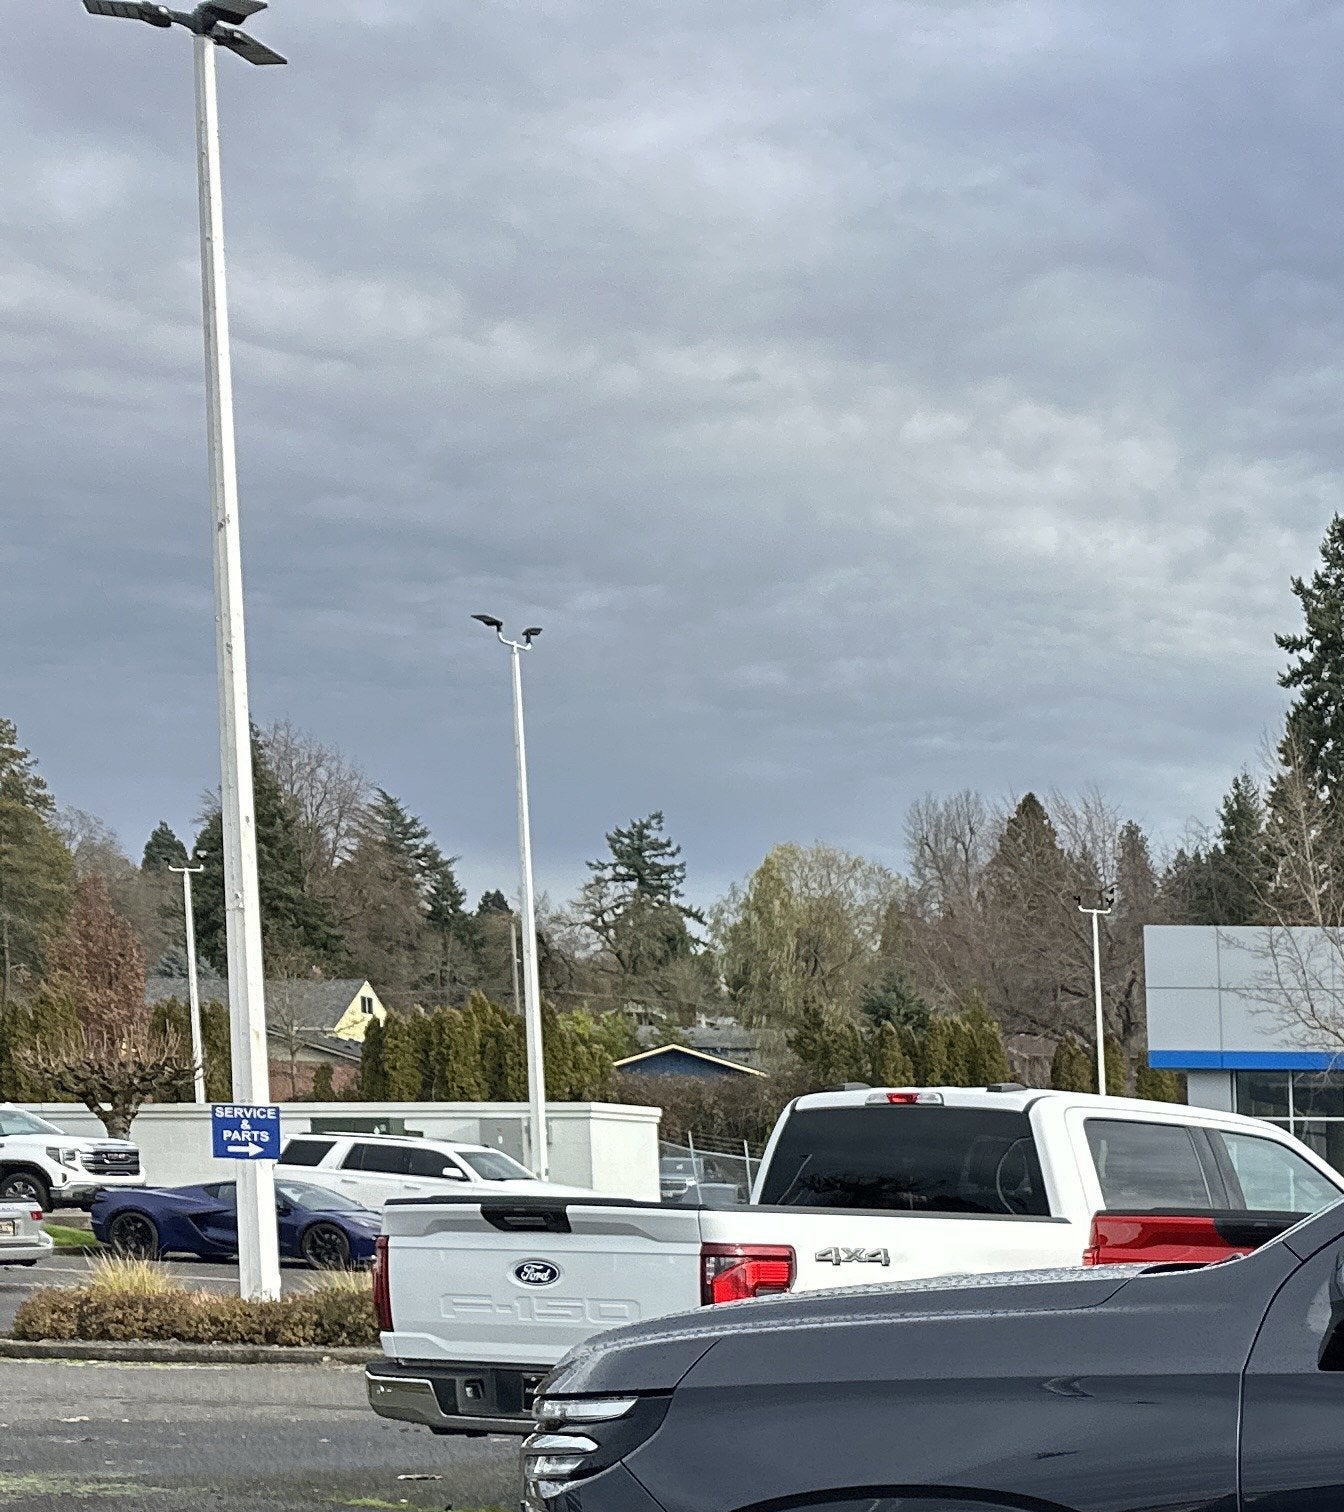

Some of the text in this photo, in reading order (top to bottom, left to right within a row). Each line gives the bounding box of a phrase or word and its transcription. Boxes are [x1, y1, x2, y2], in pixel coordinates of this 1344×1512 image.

[215, 1106, 277, 1120] SERVICE
[241, 1119, 251, 1130] &
[222, 1130, 270, 1143] PARTS
[440, 1293, 642, 1325] F-150
